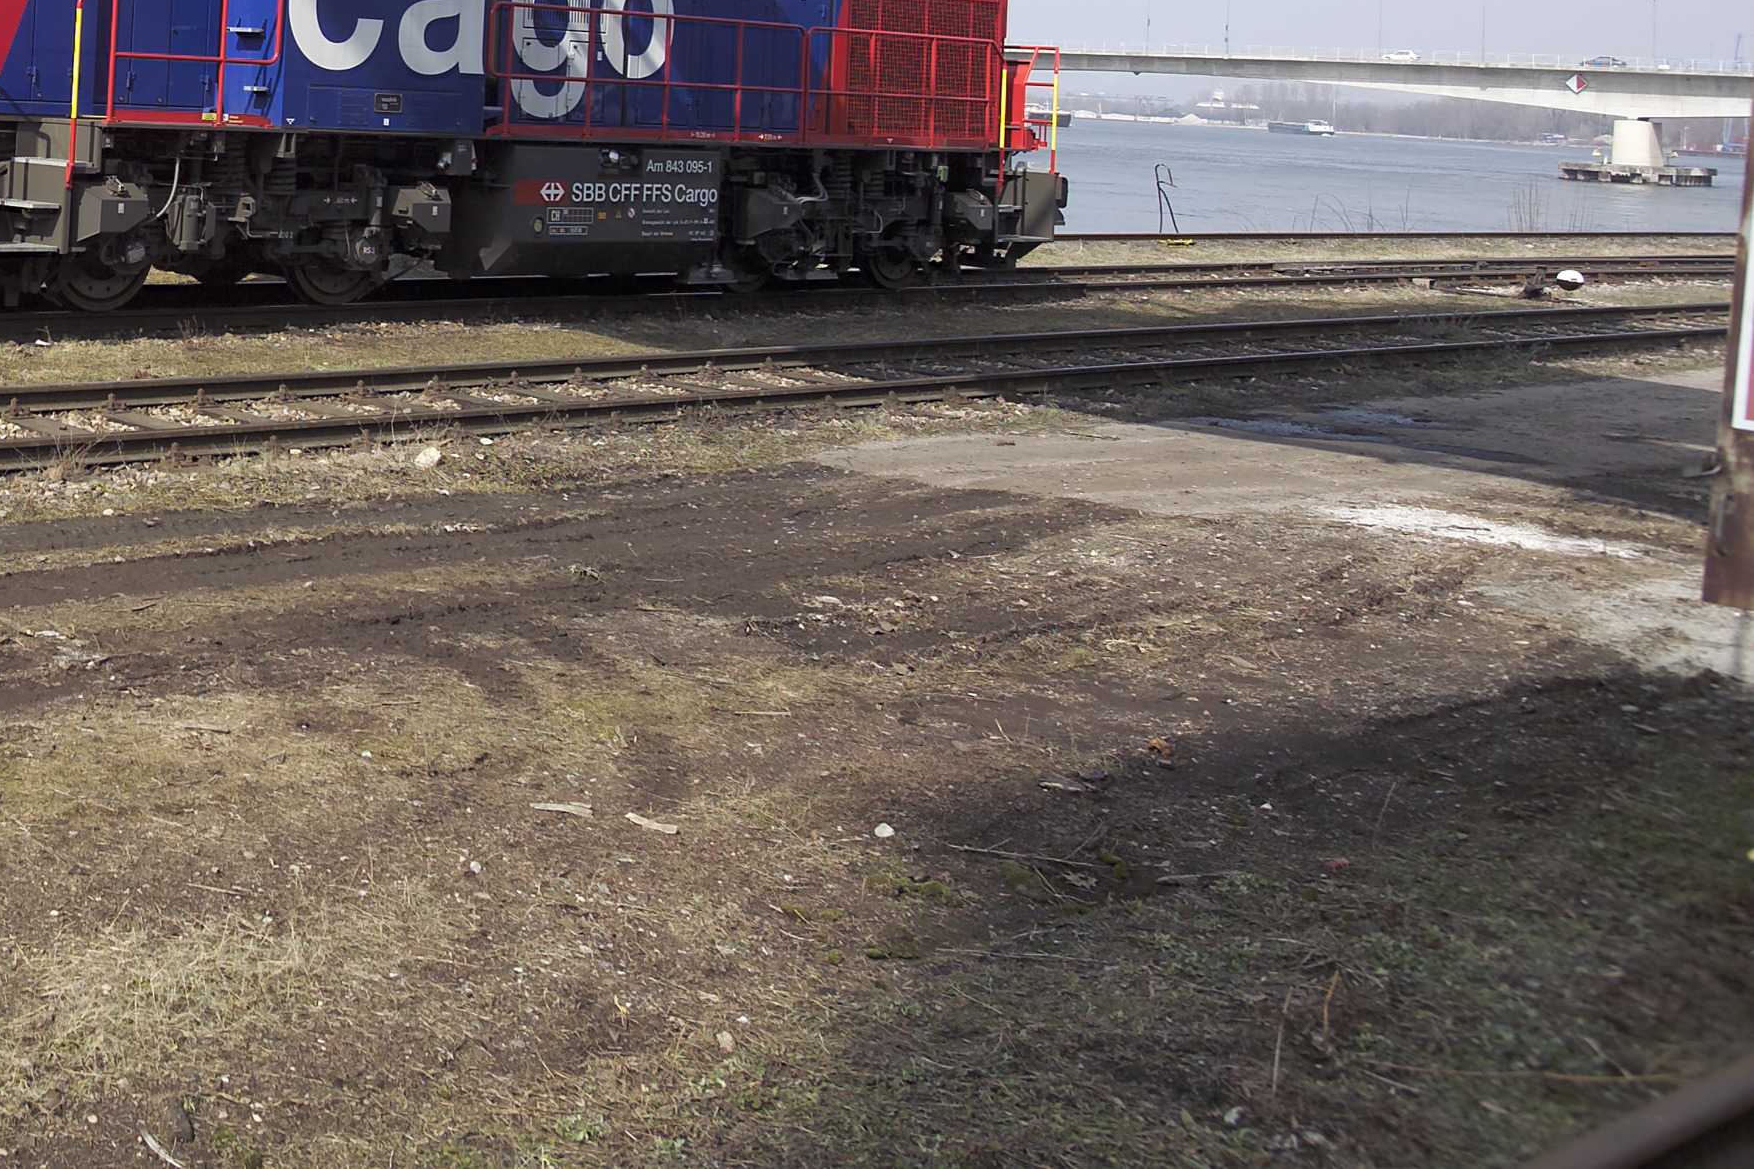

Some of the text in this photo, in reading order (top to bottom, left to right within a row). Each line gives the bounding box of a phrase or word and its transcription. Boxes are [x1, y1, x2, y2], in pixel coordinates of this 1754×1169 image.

[646, 159, 713, 173] Am 843 095-1
[571, 182, 718, 207] SBB CFF FFS Cargo
[550, 210, 560, 221] CH
